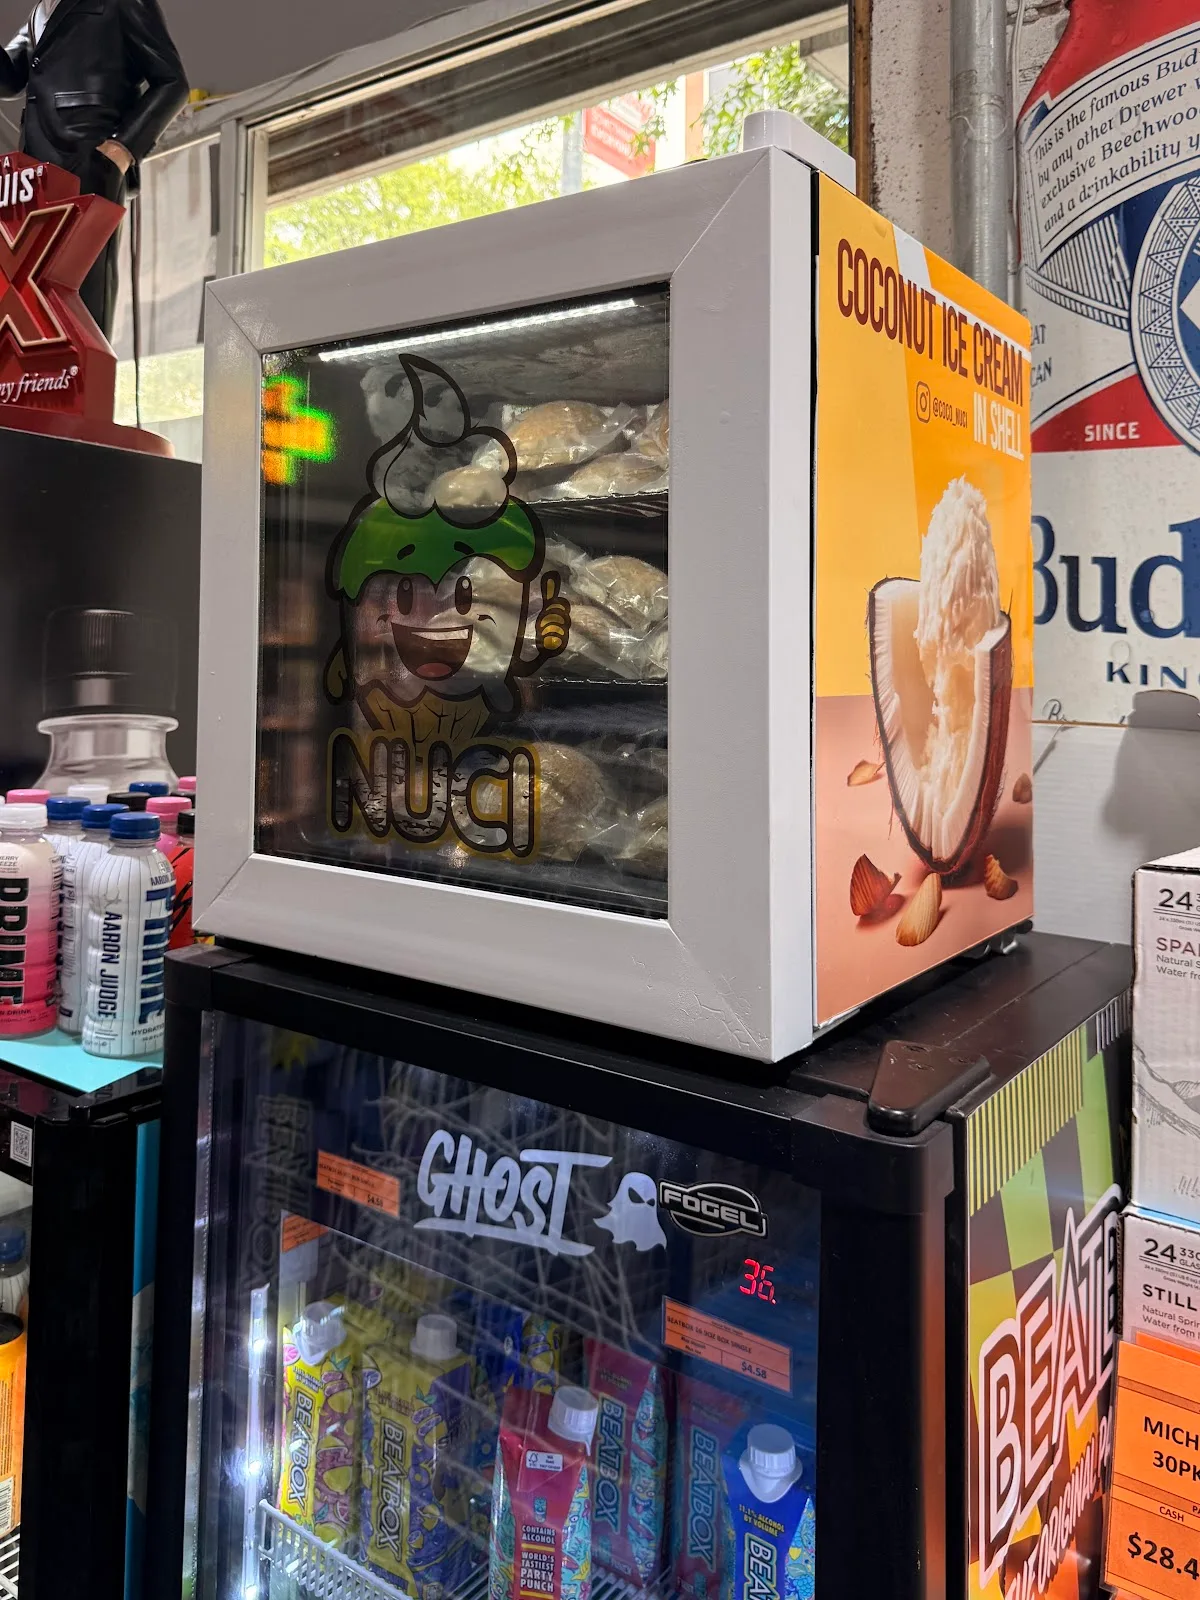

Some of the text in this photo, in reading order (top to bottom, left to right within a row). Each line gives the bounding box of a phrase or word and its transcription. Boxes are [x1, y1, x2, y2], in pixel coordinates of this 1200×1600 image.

[1034, 47, 1200, 163] This is the famous Bud
[1038, 167, 1049, 187] by
[1052, 145, 1073, 172] any
[1077, 117, 1114, 151] other
[1041, 106, 1200, 209] exclusive Beechwoo
[1044, 202, 1065, 232] and
[1067, 198, 1076, 212] a
[1079, 140, 1181, 203] drinkability
[838, 238, 1023, 407] COCONUT ICE CREAM
[13, 368, 70, 402] friends
[974, 391, 1024, 462] IN SHELL
[1085, 421, 1140, 443] SINCE
[1106, 660, 1200, 690] KIN
[1158, 888, 1193, 911] 24
[101, 910, 123, 967] AARON
[1156, 953, 1193, 967] Natural
[1156, 964, 1188, 978] Water
[98, 968, 120, 1019] JUDGE
[414, 1128, 613, 1257] GHOST
[663, 1188, 760, 1231] FOGEL
[1143, 1237, 1177, 1263] 24
[1142, 1283, 1198, 1312] STILL
[1142, 1304, 1176, 1322] Natural
[1142, 1314, 1195, 1340] Water from
[741, 1361, 767, 1379] $4.58
[289, 1391, 314, 1510] BEATBOX
[596, 1398, 624, 1527] BEATBOX
[380, 1423, 405, 1553] BEATBOX
[692, 1431, 716, 1566] BEATBOX
[522, 1524, 556, 1536] CONTAINS
[753, 1518, 778, 1537] VOLUME
[1037, 1436, 1097, 1595] ORIGINAL
[1159, 1506, 1185, 1523] CASH
[522, 1533, 556, 1545] ALCOHOL
[521, 1551, 555, 1563] WORLD'S
[521, 1559, 554, 1571] TASTIEST
[749, 1540, 773, 1600] BEA
[1127, 1531, 1200, 1581] $28.4
[520, 1567, 554, 1582] PARTY
[520, 1579, 554, 1593] PUNCH
